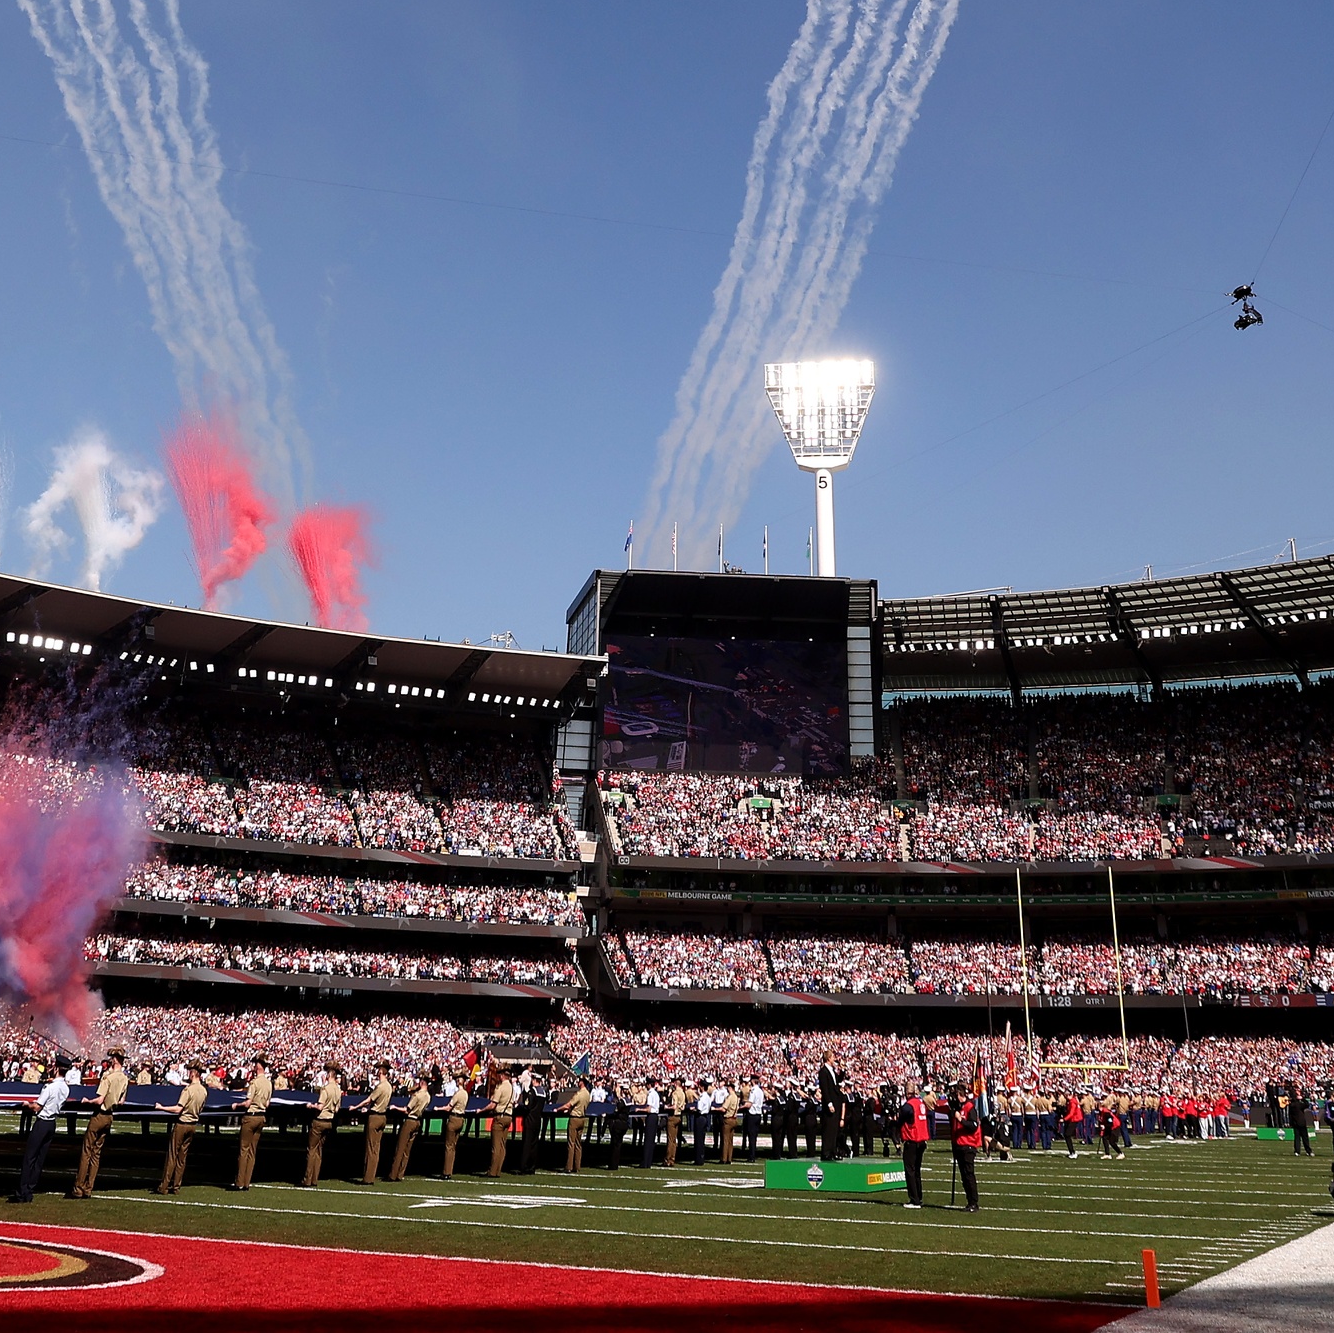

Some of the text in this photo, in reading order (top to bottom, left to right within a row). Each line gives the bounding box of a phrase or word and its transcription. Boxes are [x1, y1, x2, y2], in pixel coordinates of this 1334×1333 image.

[818, 476, 828, 489] 5
[667, 891, 711, 900] MELBOURNE
[1047, 996, 1072, 1007] 1:28
[1085, 997, 1100, 1005] QTR
[1281, 995, 1290, 1007] 0
